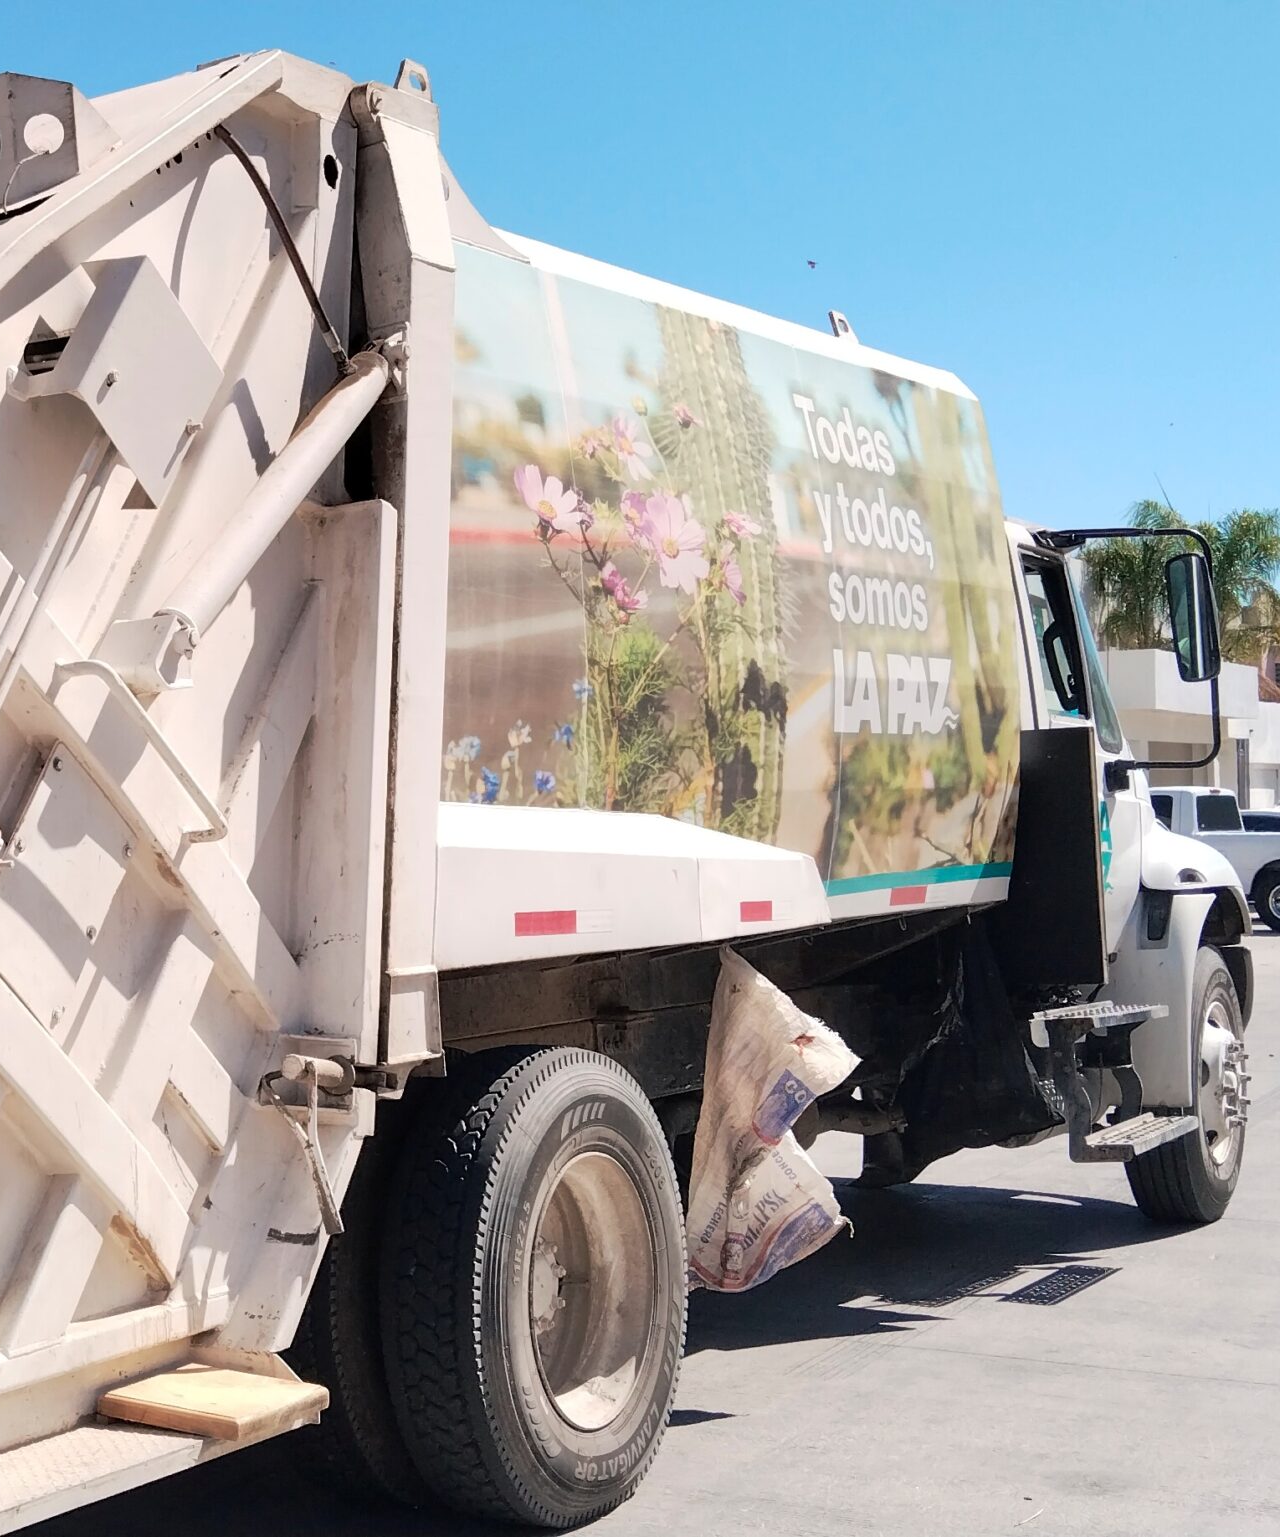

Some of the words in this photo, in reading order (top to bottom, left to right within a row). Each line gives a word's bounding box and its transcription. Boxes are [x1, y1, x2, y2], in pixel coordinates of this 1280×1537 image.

[793, 394, 895, 476] Todas
[814, 490, 832, 552] y
[837, 482, 933, 570] todos,
[828, 571, 928, 631] somos
[833, 649, 882, 734] LA
[887, 654, 952, 735] PAZ
[574, 1402, 660, 1482] LANVIGATOR
